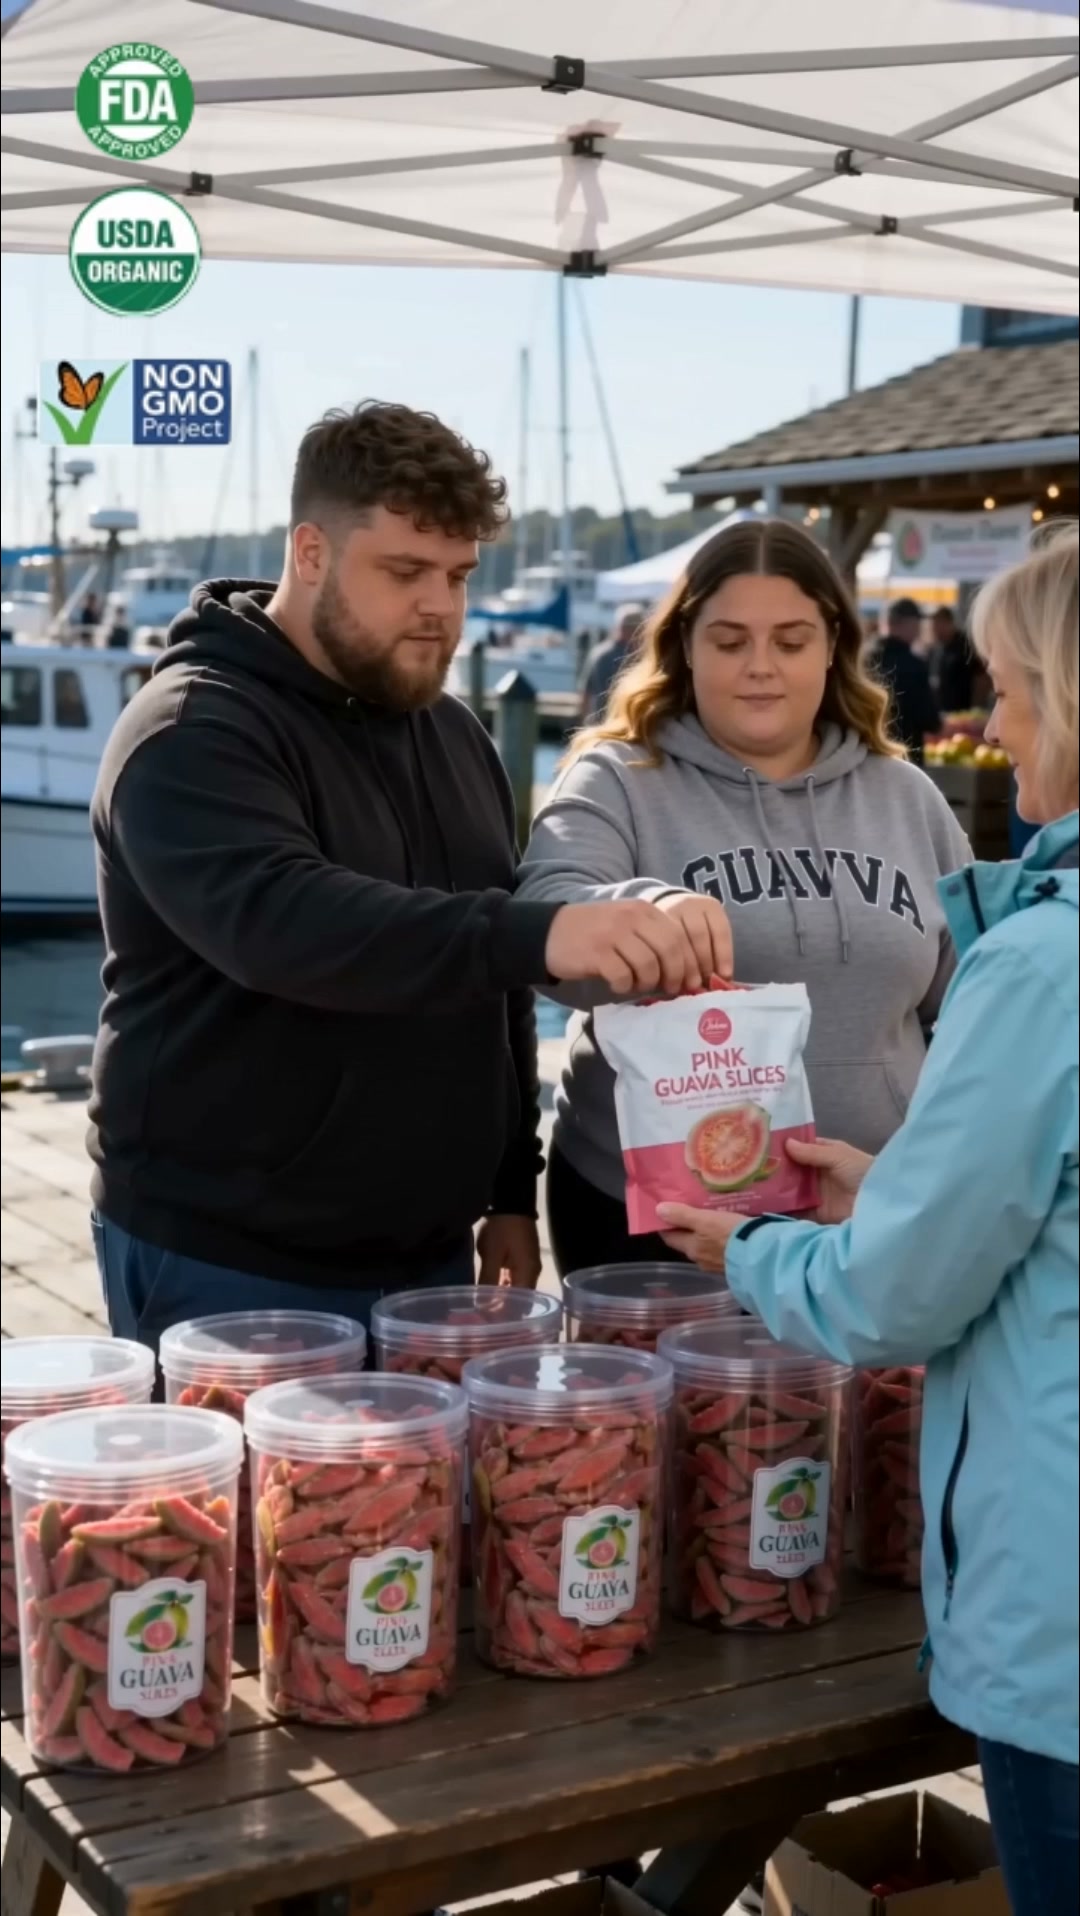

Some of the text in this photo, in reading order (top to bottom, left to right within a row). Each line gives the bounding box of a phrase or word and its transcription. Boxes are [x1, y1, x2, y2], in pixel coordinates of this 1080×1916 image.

[681, 846, 926, 938] GUAVVA
[691, 1048, 747, 1072] PINK
[654, 1072, 723, 1098] GUAVA
[728, 1065, 786, 1088] SLICES
[758, 1531, 820, 1553] GUAVA
[568, 1579, 630, 1600] GUAVA
[355, 1623, 422, 1646] GUAVA
[120, 1660, 195, 1690] GUAVA
